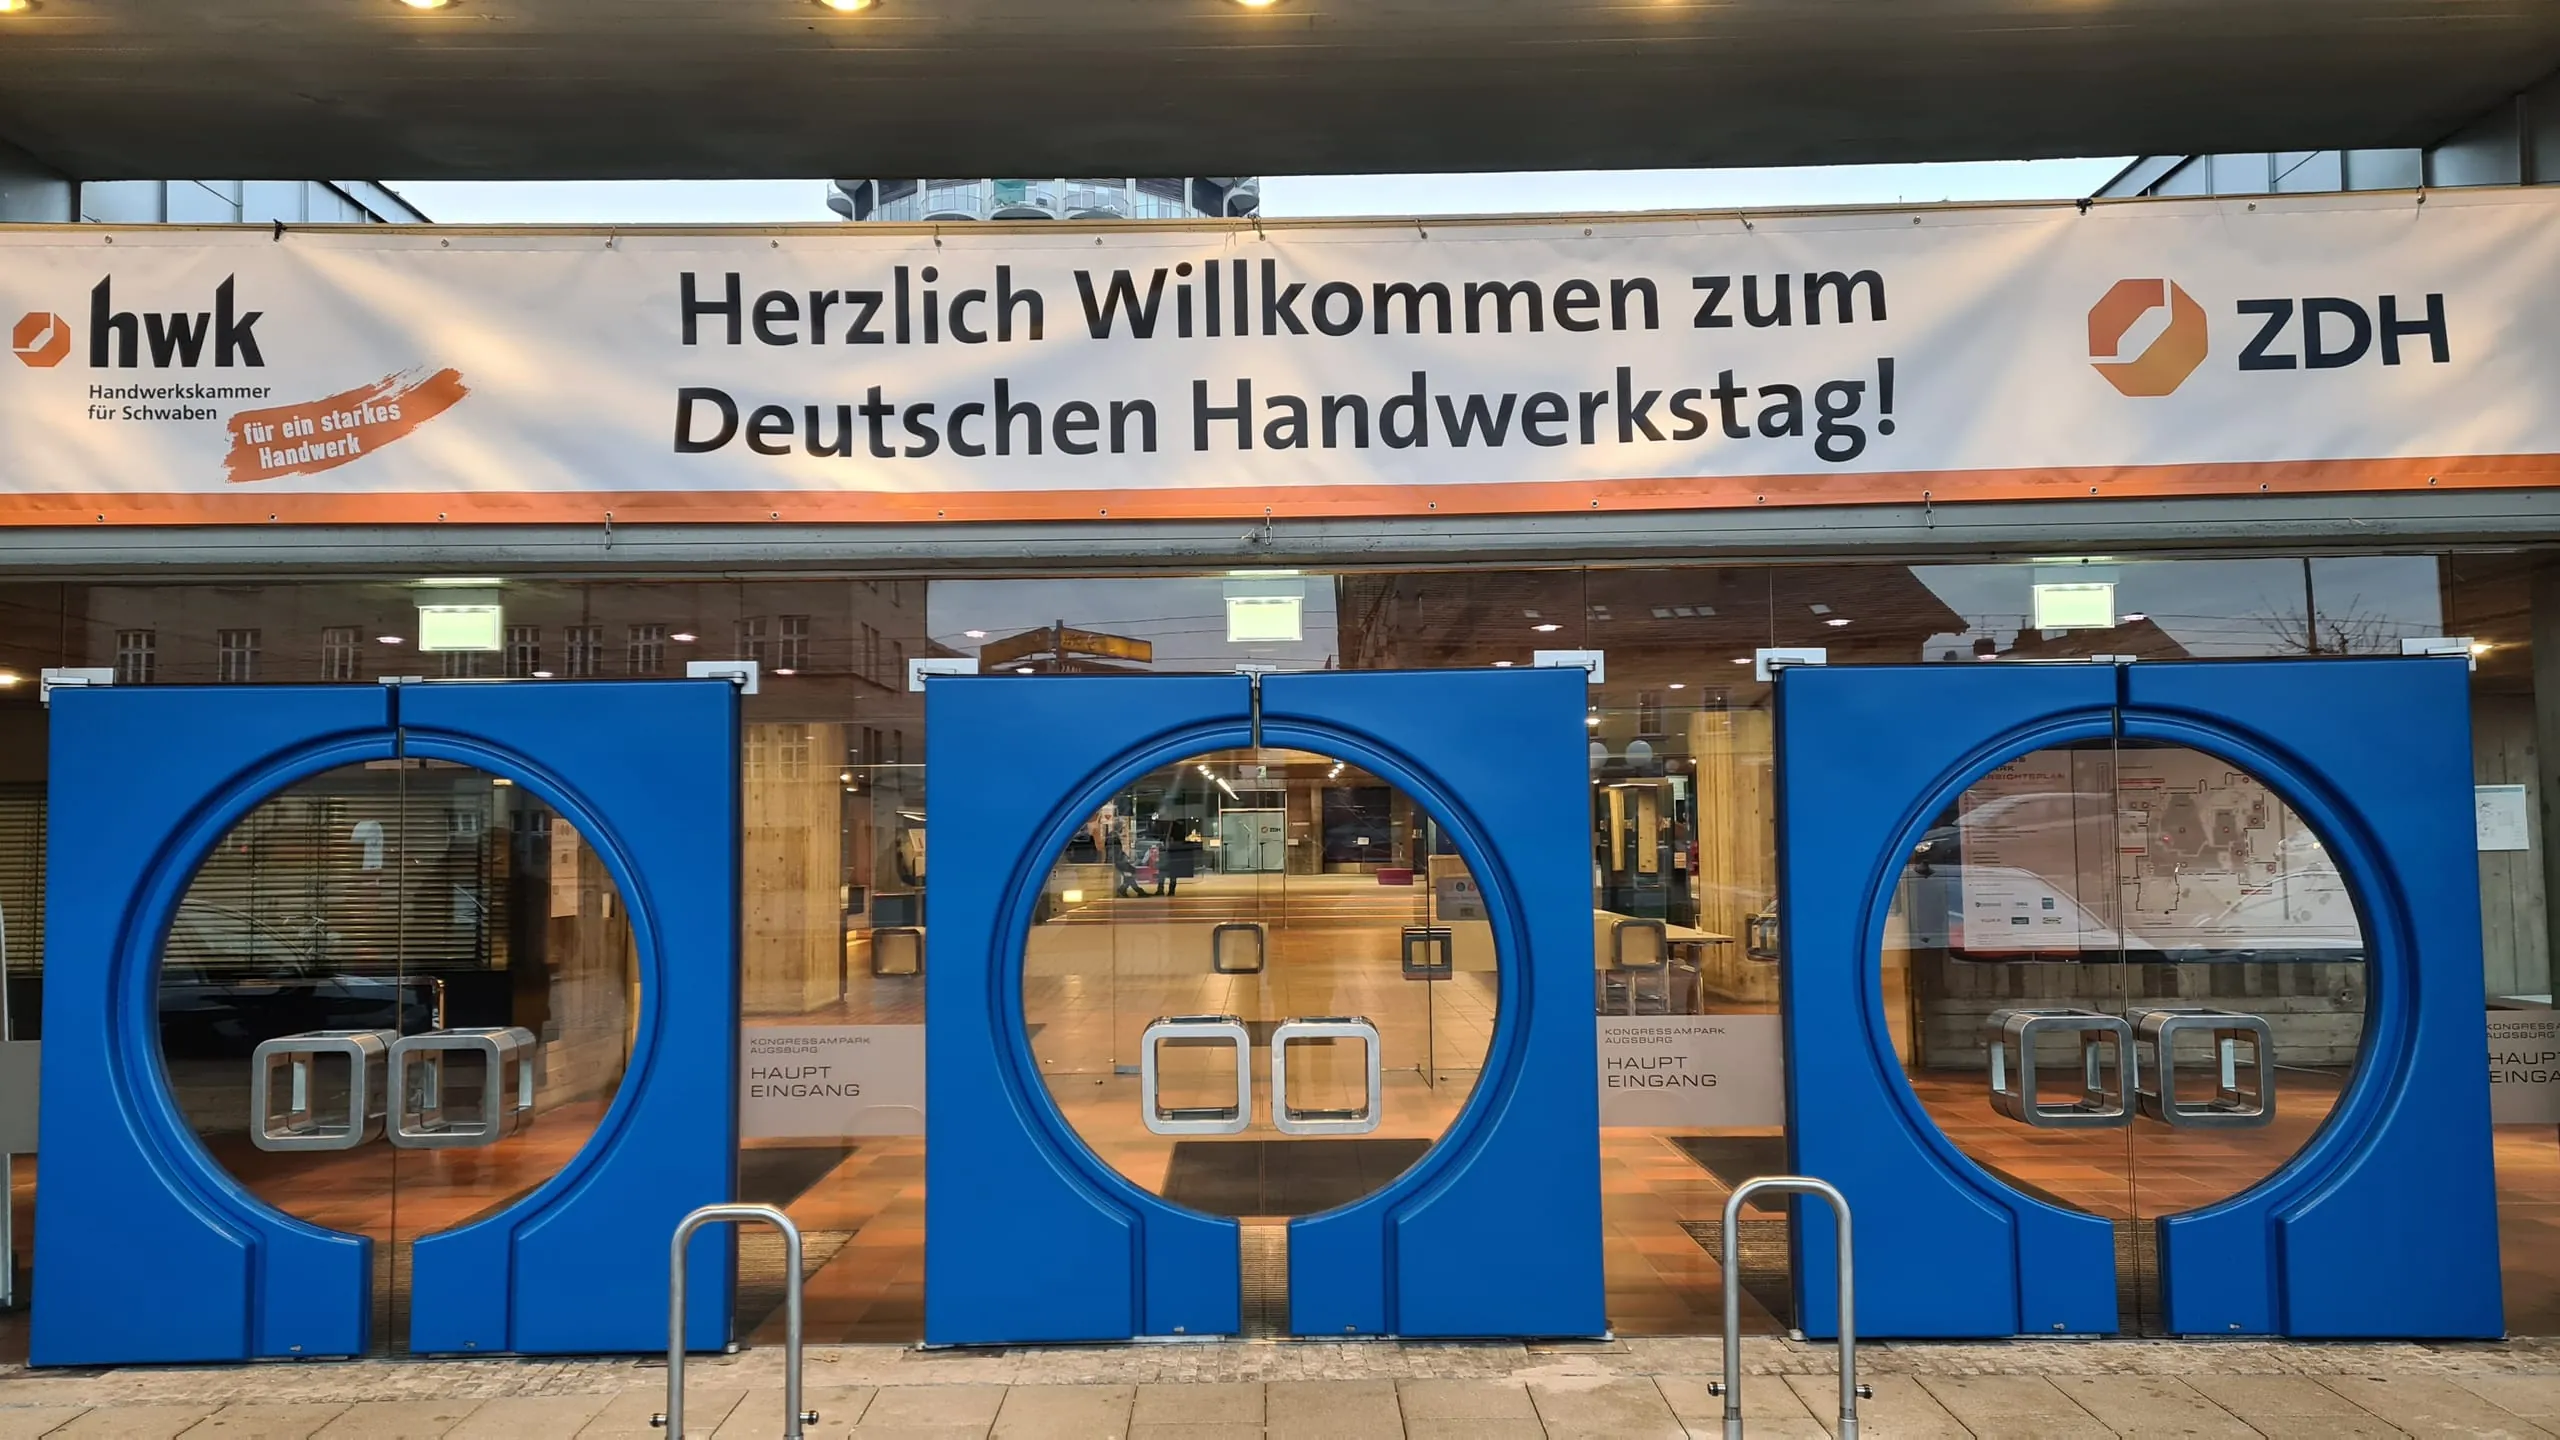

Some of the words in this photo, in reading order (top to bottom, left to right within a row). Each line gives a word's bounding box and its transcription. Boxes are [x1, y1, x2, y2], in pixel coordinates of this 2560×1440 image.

[680, 265, 1044, 345] Herzlich
[1073, 259, 1660, 343] Willkommen
[1692, 268, 1887, 328] zum
[90, 272, 265, 368] hwk
[2237, 293, 2450, 370] ZDH
[89, 384, 271, 400] Handwerkskammer
[88, 405, 116, 420] für
[122, 405, 217, 420] Schwaben
[674, 378, 1157, 458] Deutschen
[1192, 358, 1896, 462] Handwerkstag!
[243, 421, 274, 446] für
[282, 415, 313, 439] ein
[321, 401, 401, 434] starkes
[259, 433, 361, 470] Handwerk
[1694, 1027, 1725, 1035] PARK
[1605, 1036, 1673, 1044] AUGSBURG
[750, 1046, 818, 1054] AUGSBURG
[1607, 1056, 1688, 1070] HAUPT
[751, 1066, 832, 1079] HAUPT
[1608, 1074, 1718, 1088] EINGANG
[751, 1083, 860, 1098] EINGANG
